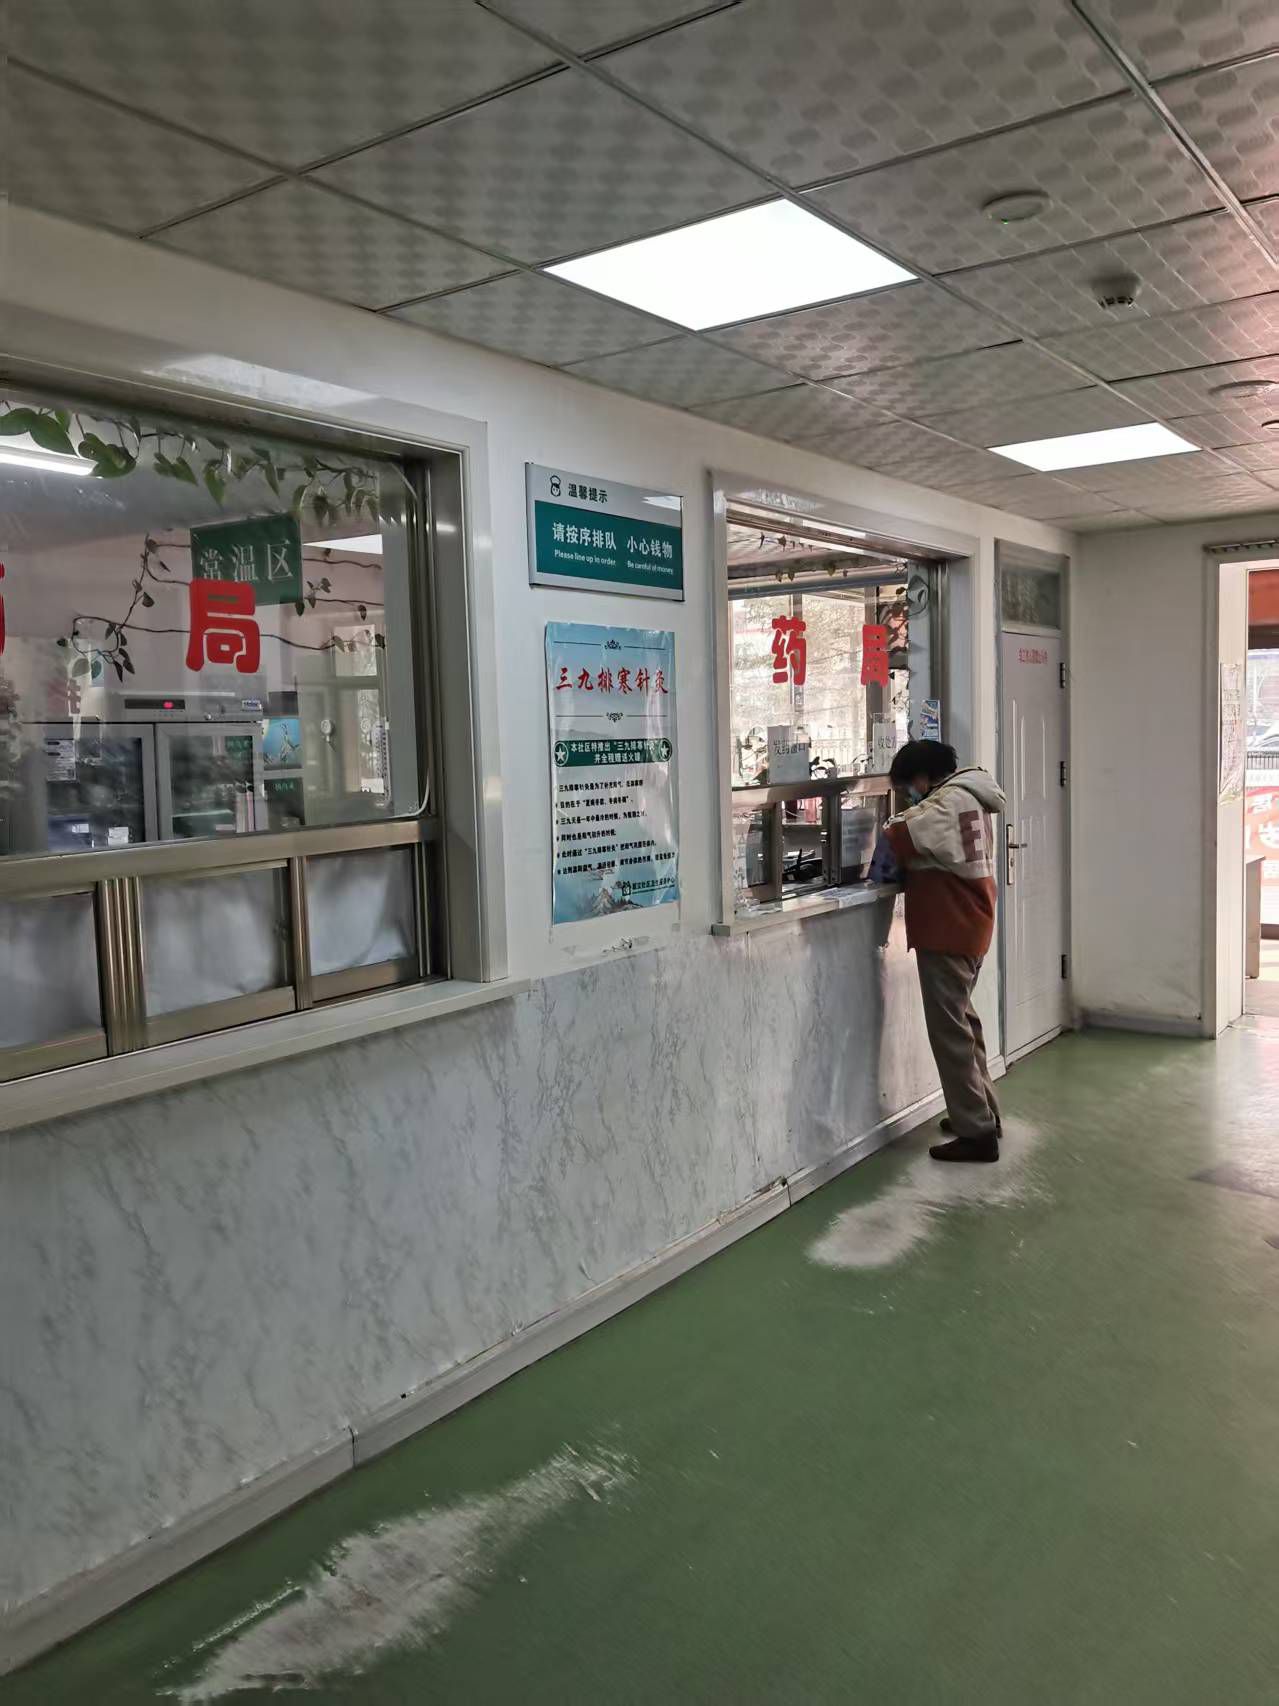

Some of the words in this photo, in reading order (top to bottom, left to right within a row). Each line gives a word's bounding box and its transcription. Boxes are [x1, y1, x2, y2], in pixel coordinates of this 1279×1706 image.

[568, 483, 608, 504] 温馨提示
[552, 521, 617, 551] 请按序排队
[626, 535, 673, 559] 小心钱物
[199, 540, 295, 584] 常温区
[554, 549, 574, 561] Please
[574, 552, 586, 562] line
[586, 556, 593, 565] up
[594, 556, 600, 564] in
[601, 557, 616, 567] order
[627, 560, 634, 568] Be
[634, 562, 651, 571] careful
[186, 578, 261, 674] 局
[555, 666, 668, 697] 三九排寒针灸
